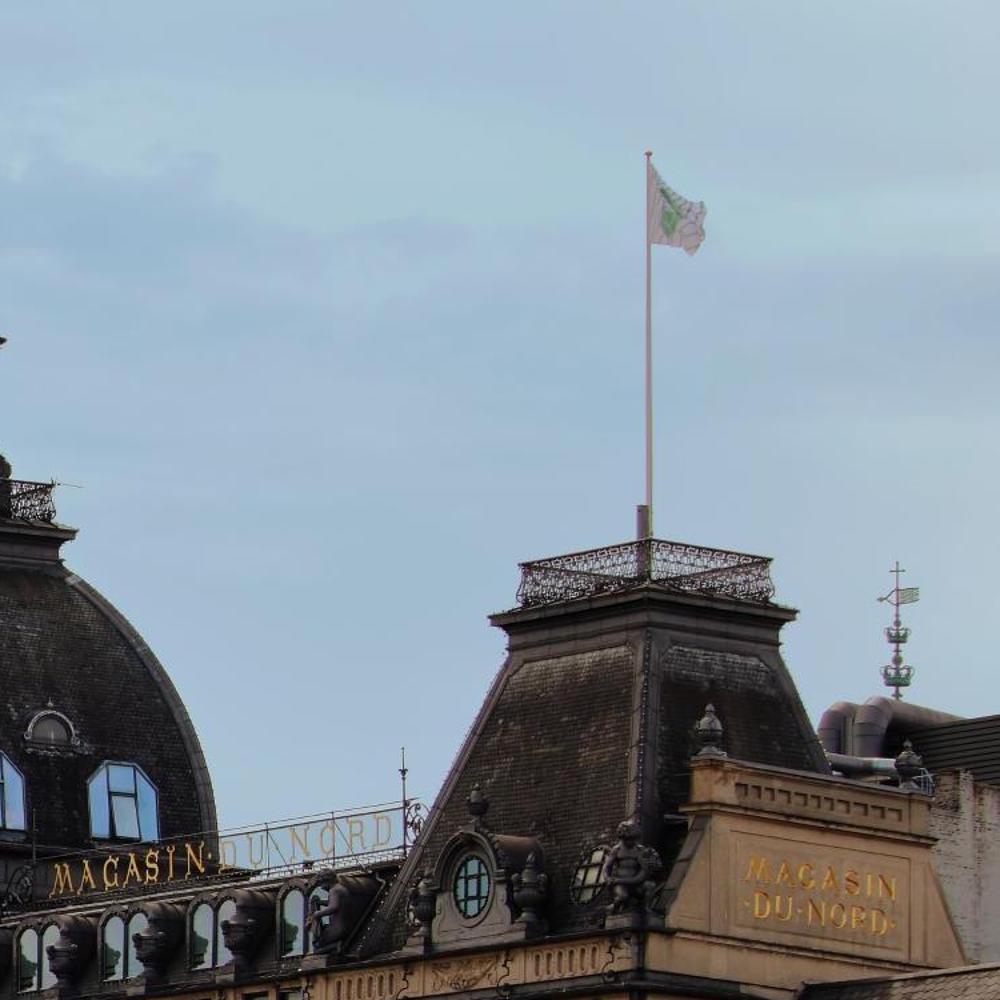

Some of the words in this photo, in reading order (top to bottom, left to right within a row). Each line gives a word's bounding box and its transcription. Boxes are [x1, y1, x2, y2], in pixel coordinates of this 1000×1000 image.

[49, 841, 206, 898] MAGASIN
[218, 834, 265, 874] DU
[289, 812, 393, 863] NORD
[747, 857, 896, 901] MAGASIN
[753, 891, 793, 921] DU
[808, 899, 889, 936] NORD
